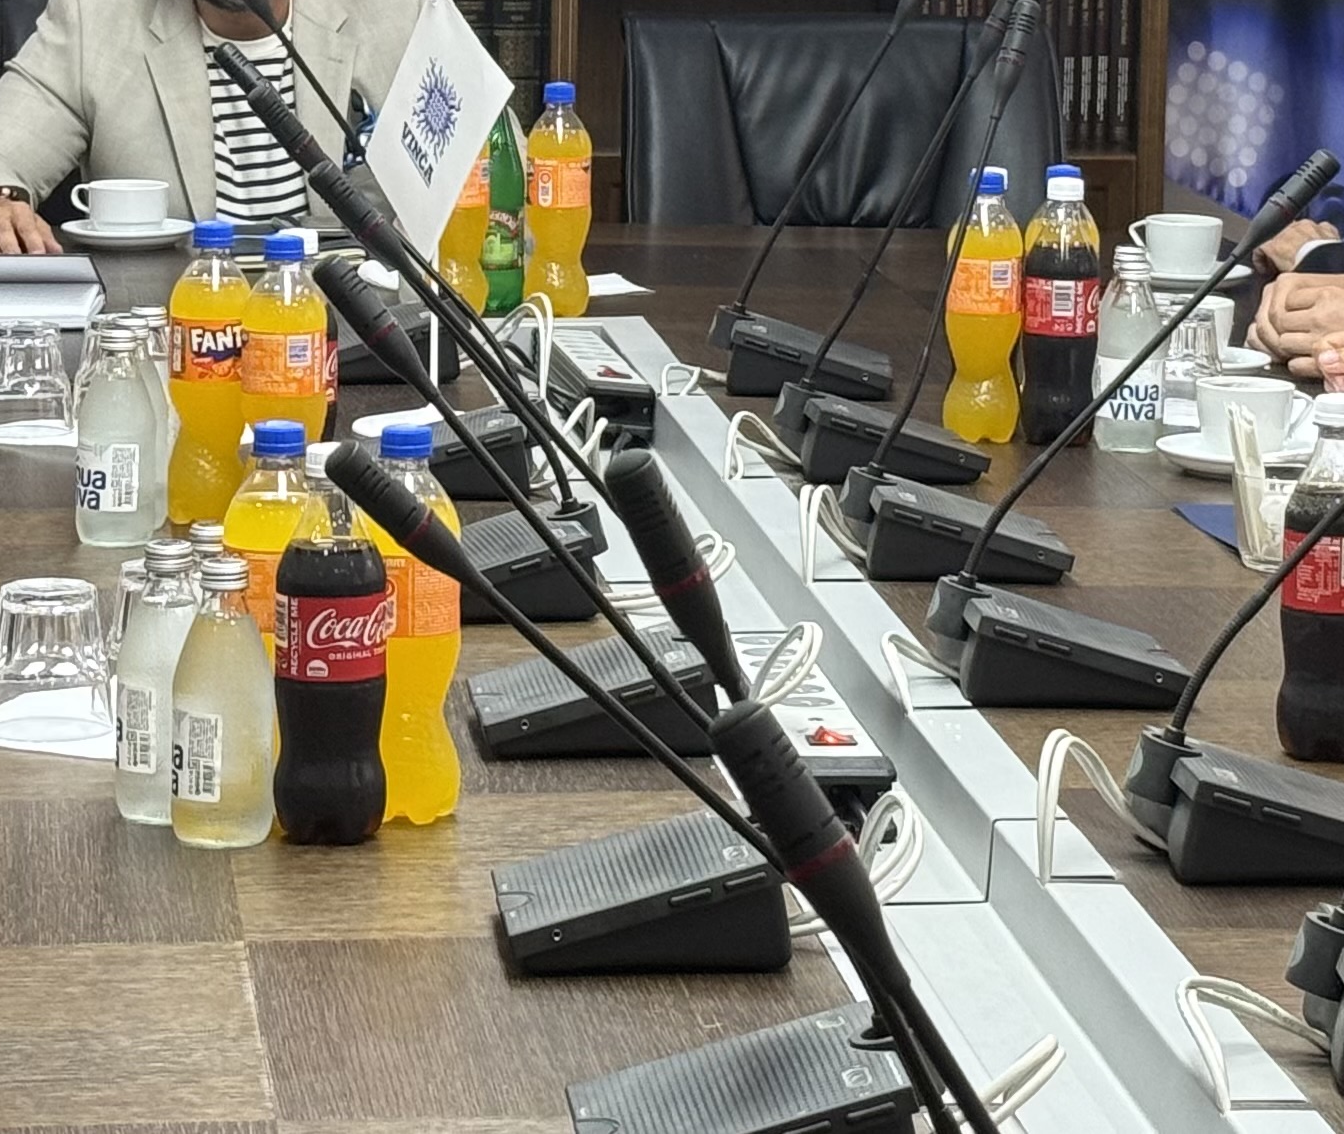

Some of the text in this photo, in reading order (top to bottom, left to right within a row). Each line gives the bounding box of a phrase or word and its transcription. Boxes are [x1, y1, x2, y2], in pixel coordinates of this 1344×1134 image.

[401, 121, 434, 182] VINČA
[191, 325, 243, 353] FANT
[1110, 402, 1156, 420] viva
[289, 597, 300, 676] RECYCLE ME
[328, 650, 372, 661] ORIGINAL
